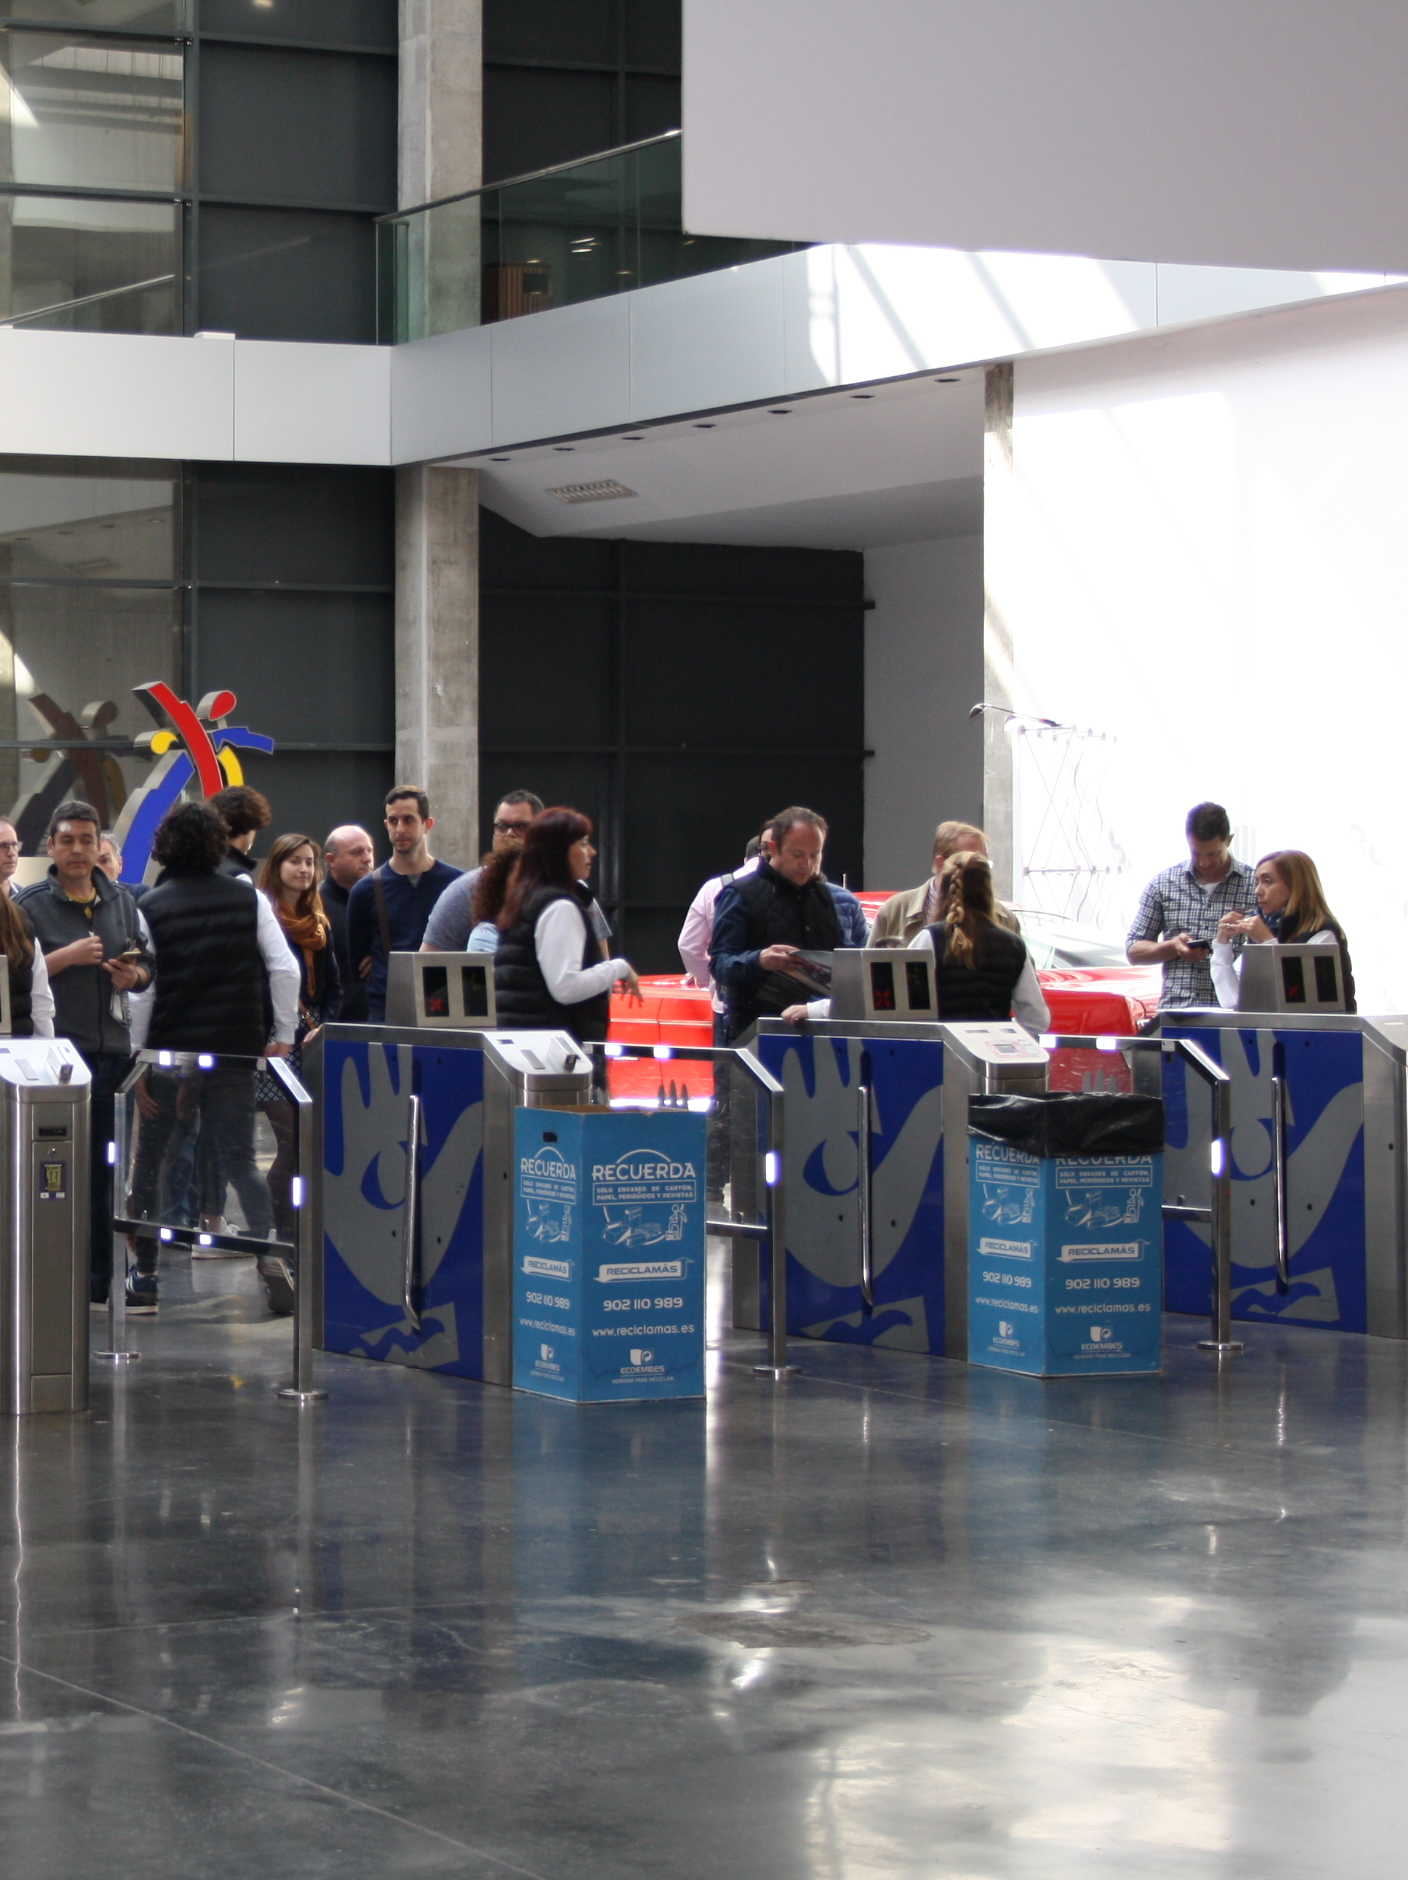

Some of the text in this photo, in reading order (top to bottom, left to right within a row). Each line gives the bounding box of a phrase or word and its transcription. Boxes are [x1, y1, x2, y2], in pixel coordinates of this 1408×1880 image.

[520, 1158, 576, 1180] RECUERDA
[592, 1162, 696, 1181] RECUERDA
[982, 1271, 1000, 1284] 902
[1014, 1276, 1032, 1288] 989
[1065, 1277, 1140, 1290] 902 110 989
[526, 1291, 542, 1304] 902
[554, 1296, 570, 1310] 989
[603, 1297, 684, 1312] 902 110 989
[591, 1323, 695, 1337] www.reciclamas.es
